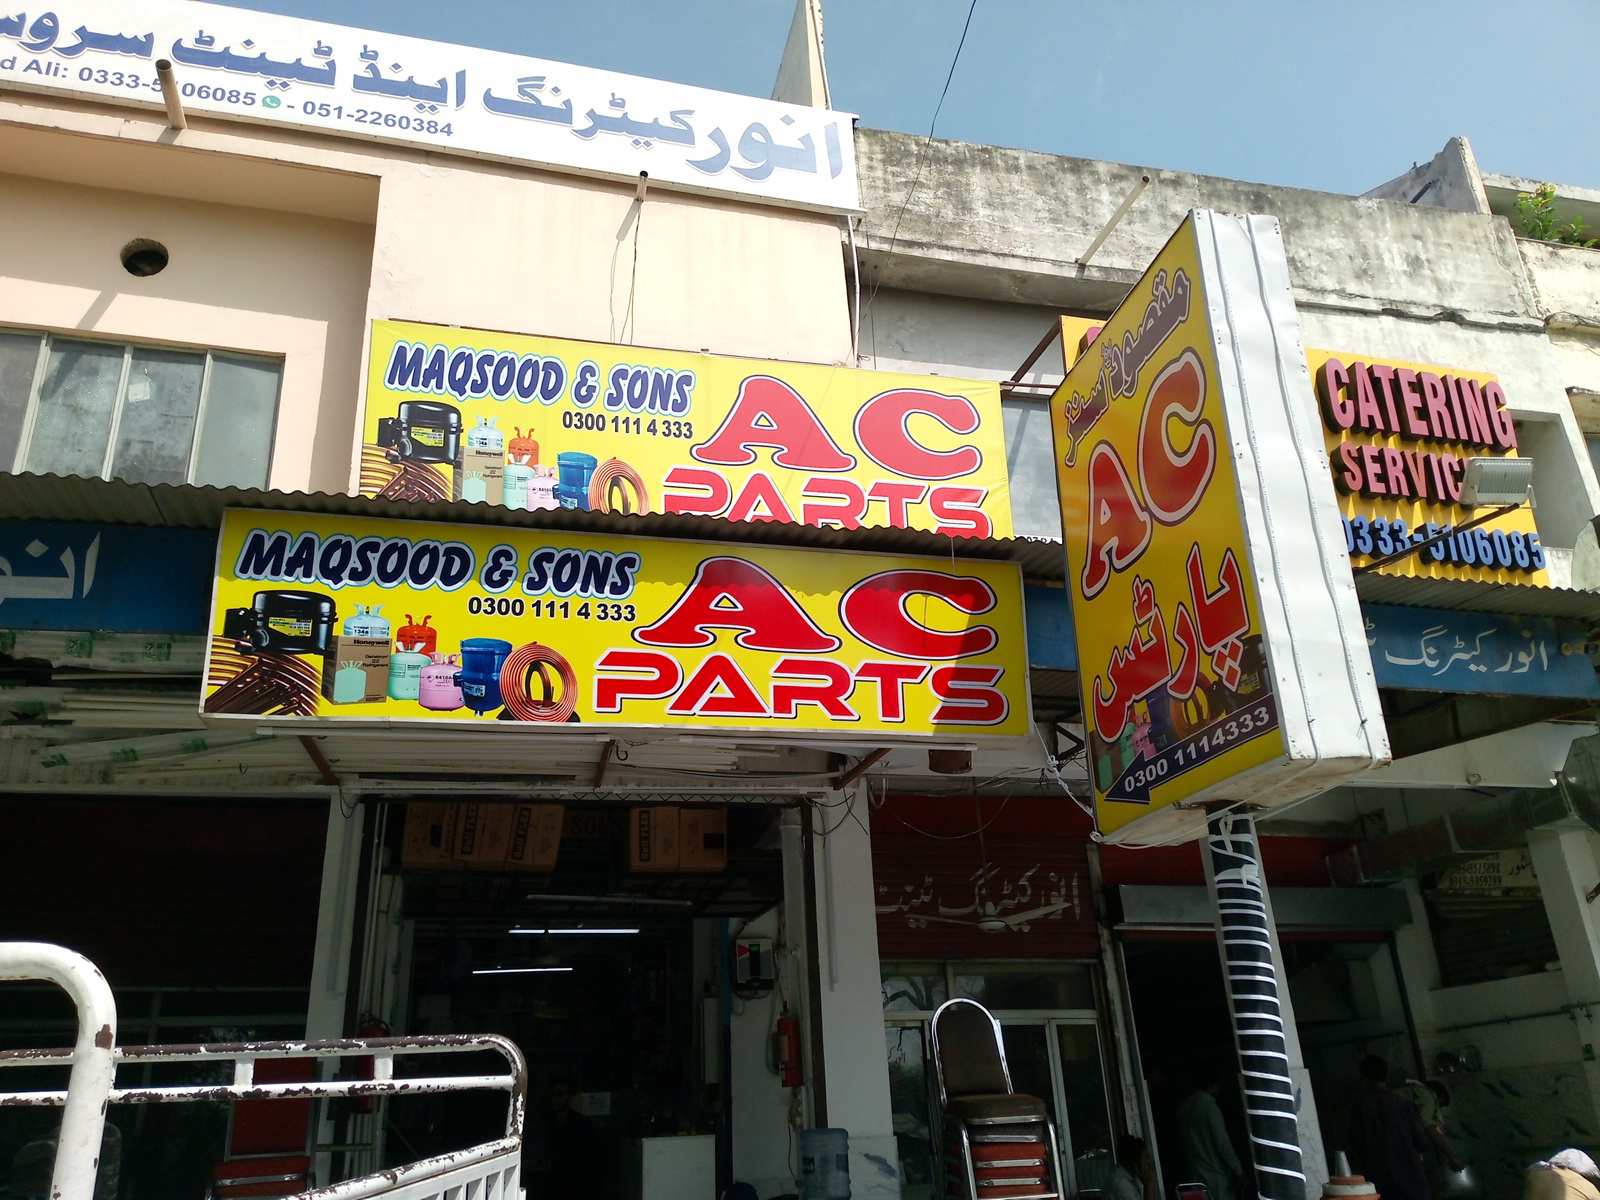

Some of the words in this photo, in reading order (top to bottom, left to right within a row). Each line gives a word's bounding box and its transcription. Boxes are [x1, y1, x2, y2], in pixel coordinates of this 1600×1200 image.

[170, 29, 337, 91] ٹینٹ
[352, 44, 467, 113] اینڈ
[23, 59, 69, 78] Ali:
[78, 67, 256, 107] 0333-506085
[302, 100, 454, 137] 051-2260384
[482, 75, 695, 150] کیٹرنگ
[685, 114, 842, 182] انور
[386, 343, 565, 403] MAQSOOD
[573, 362, 599, 406] &
[606, 366, 694, 415] SONS
[1321, 358, 1518, 449] CATERING
[562, 411, 606, 432] 0300
[690, 375, 983, 480] AC
[662, 464, 994, 540] PARTS
[1081, 347, 1217, 600] AC
[1339, 441, 1466, 502] SERVIC
[236, 529, 475, 590] MAQSOOD
[483, 546, 516, 592] &
[524, 548, 640, 598] SONS
[468, 596, 524, 618] 0300
[631, 556, 999, 659] AC
[593, 647, 1010, 727] PARTS
[1124, 758, 1169, 793] 0300
[1174, 706, 1271, 766] 1114333
